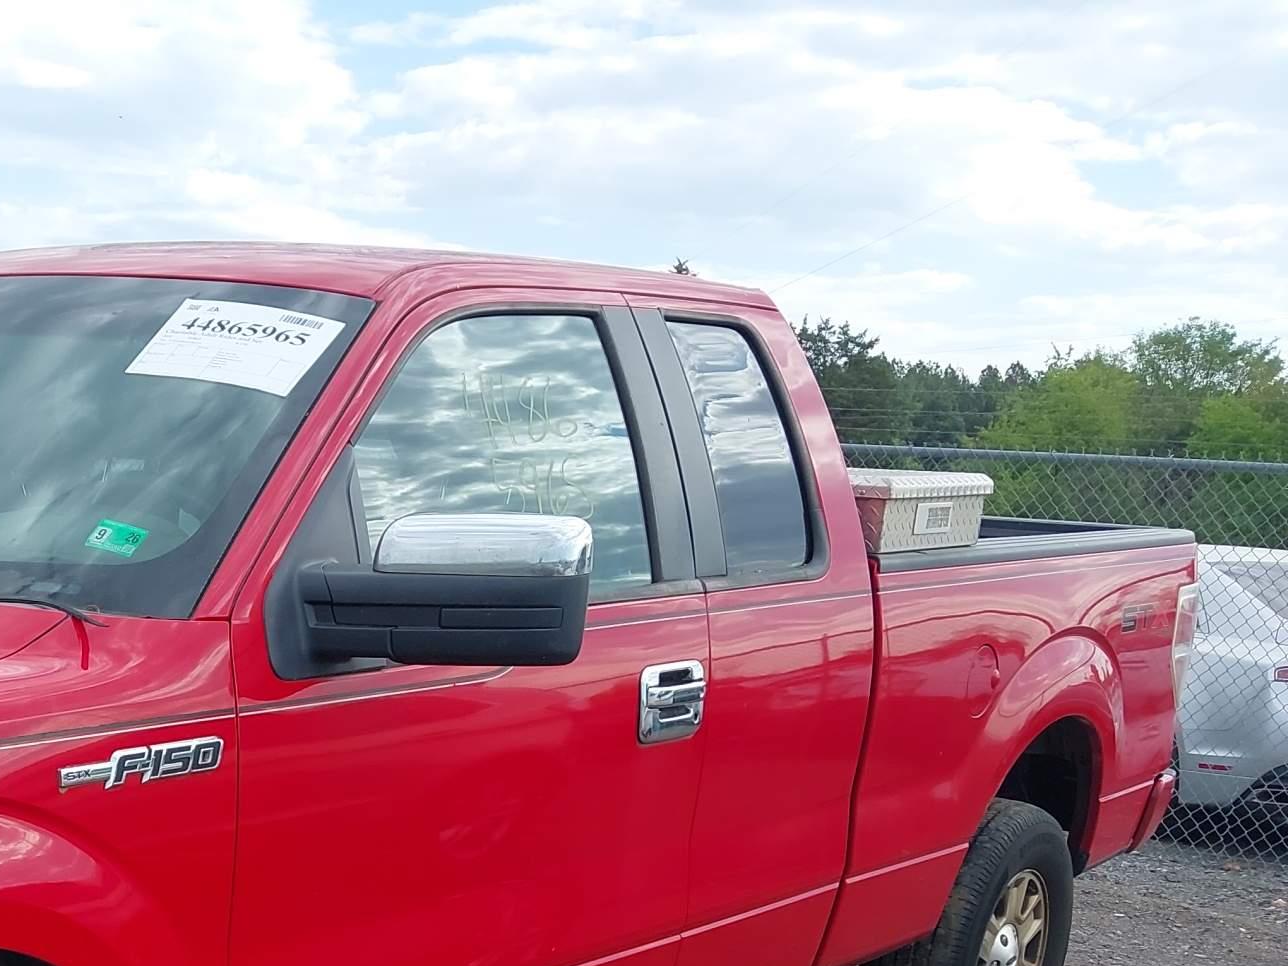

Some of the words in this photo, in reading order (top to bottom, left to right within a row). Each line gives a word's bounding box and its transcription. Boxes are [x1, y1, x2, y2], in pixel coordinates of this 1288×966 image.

[181, 316, 312, 347] 44865965
[95, 528, 108, 540] 9
[63, 768, 92, 781] STX
